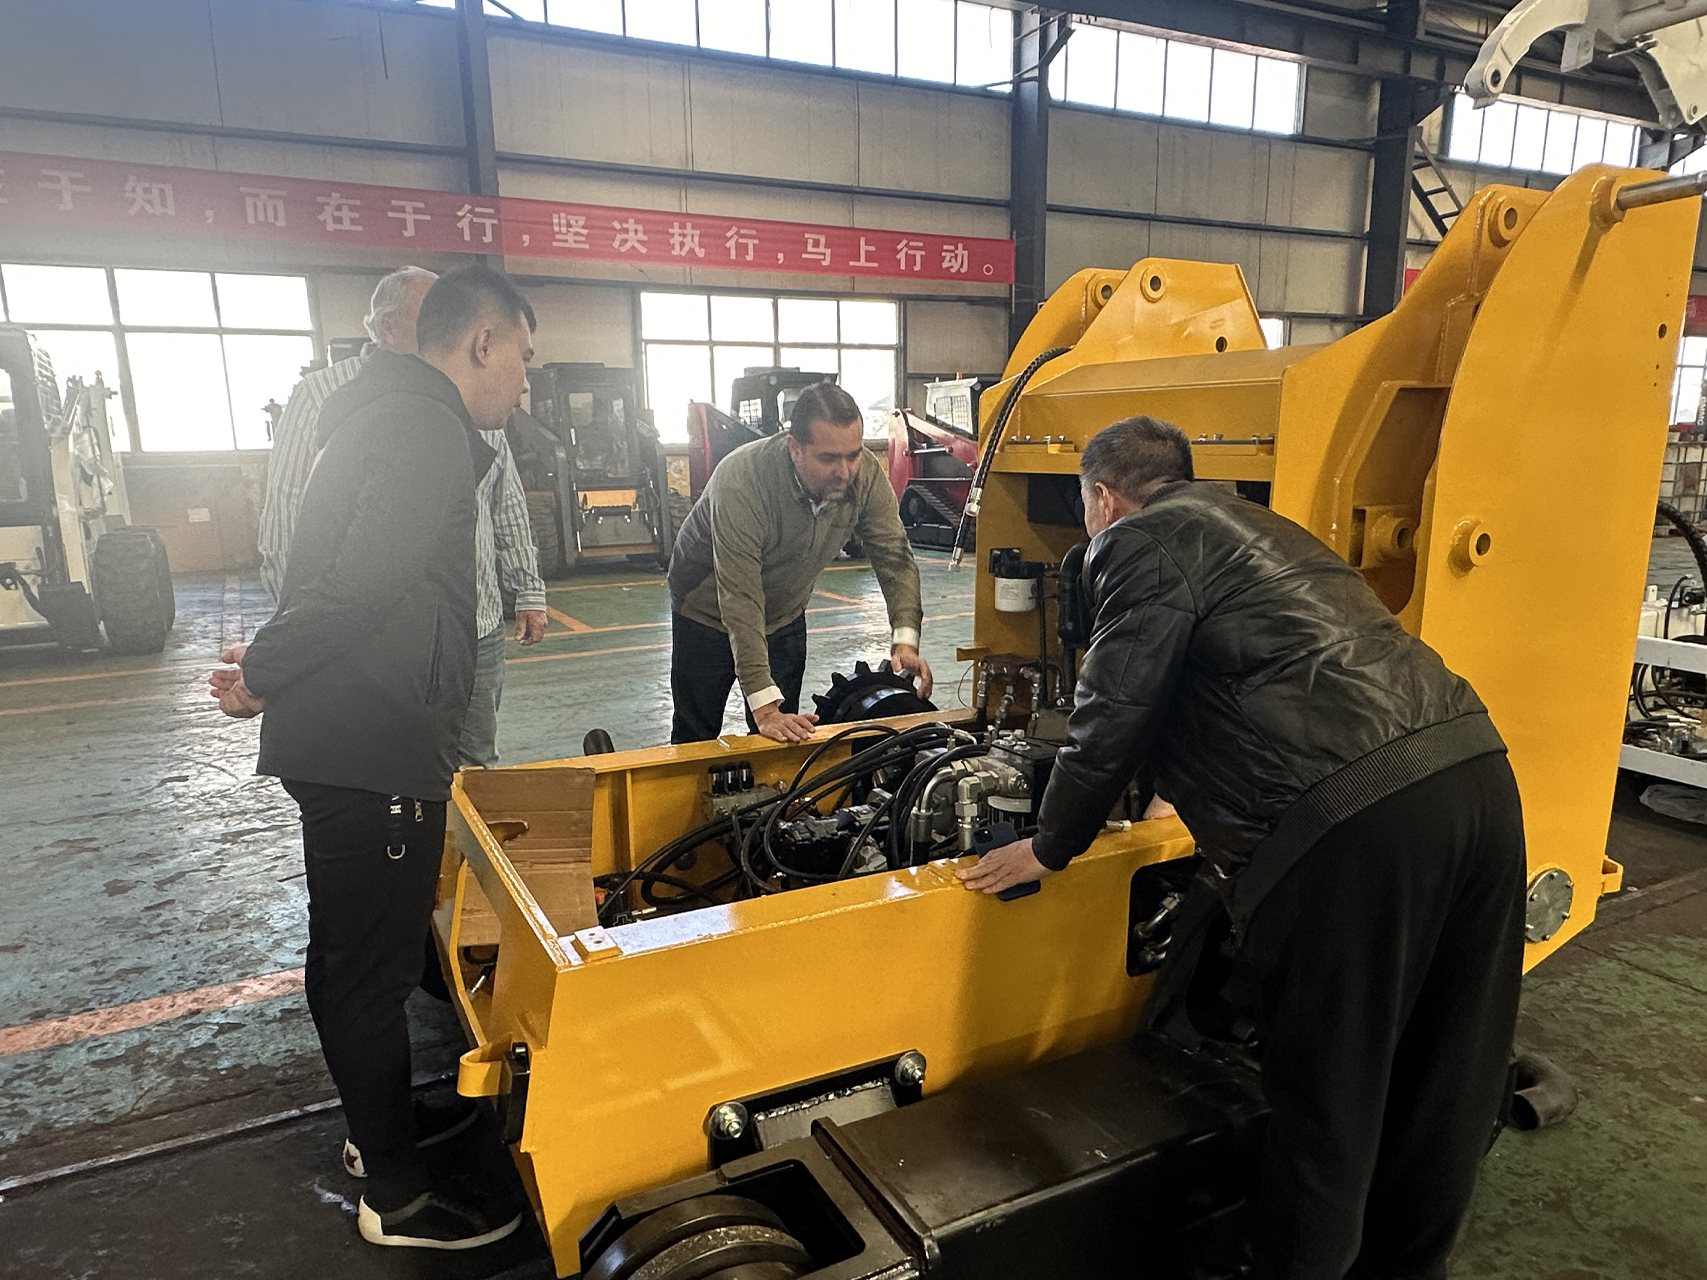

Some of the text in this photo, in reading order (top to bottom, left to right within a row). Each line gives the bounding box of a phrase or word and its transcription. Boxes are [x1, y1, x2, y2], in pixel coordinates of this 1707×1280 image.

[0, 168, 994, 275] 于知，而在于行，坚决执行，马上行动。
